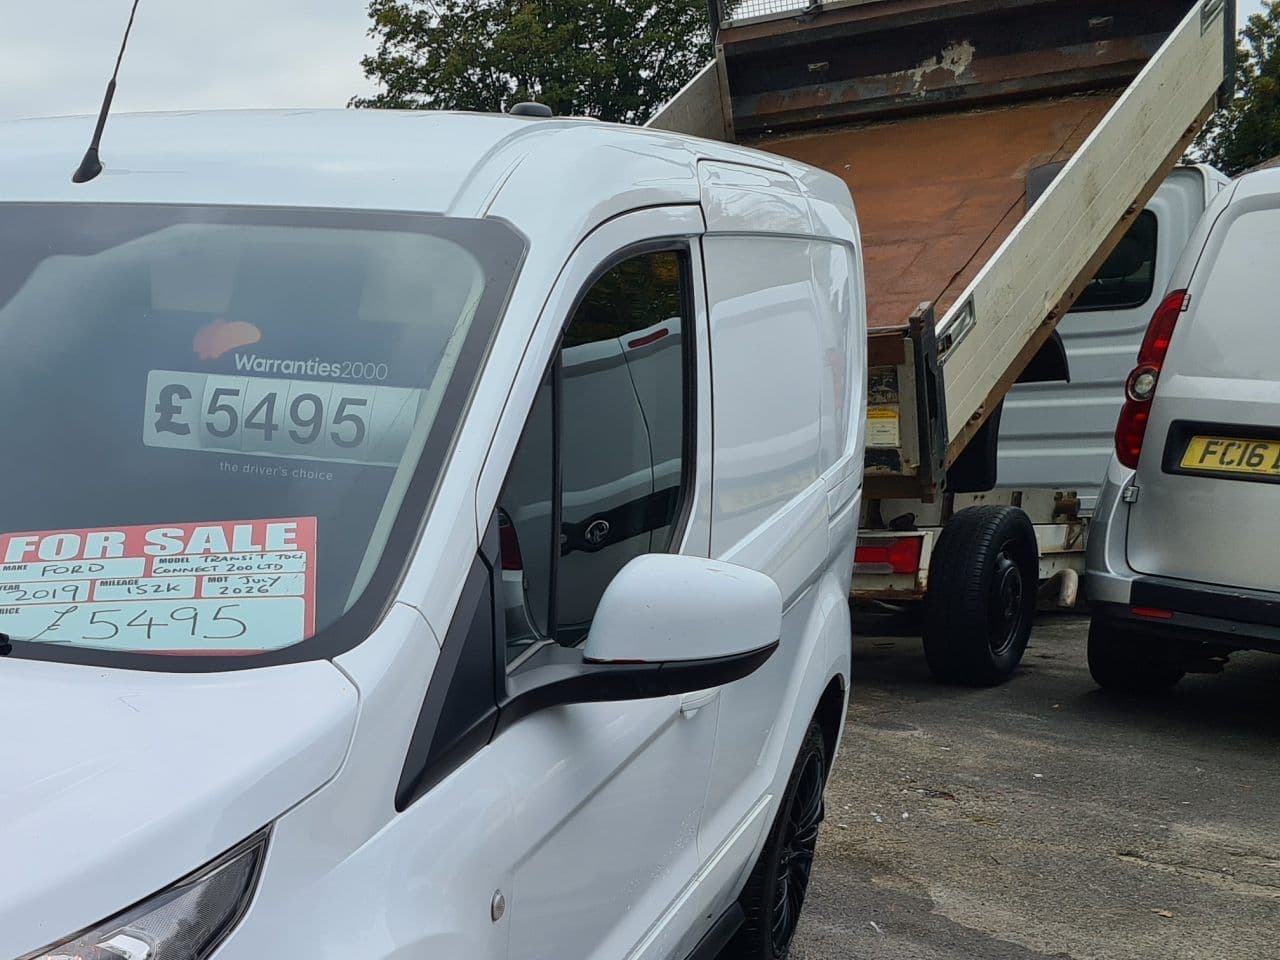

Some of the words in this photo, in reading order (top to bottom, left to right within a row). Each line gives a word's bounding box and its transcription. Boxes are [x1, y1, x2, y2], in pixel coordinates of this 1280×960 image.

[155, 383, 369, 449] £5495
[1198, 440, 1270, 468] FC16
[220, 461, 239, 472] the
[242, 463, 288, 477] driver's
[292, 467, 334, 481] choice
[4, 531, 126, 563] FOR
[143, 522, 299, 557] SALE
[42, 563, 105, 577] FORD
[226, 563, 253, 572] 200
[256, 563, 284, 571] LTD
[99, 579, 140, 587] MILEAGE
[219, 584, 270, 595] 2026
[6, 585, 80, 601] 2019
[28, 604, 248, 643] £5495
